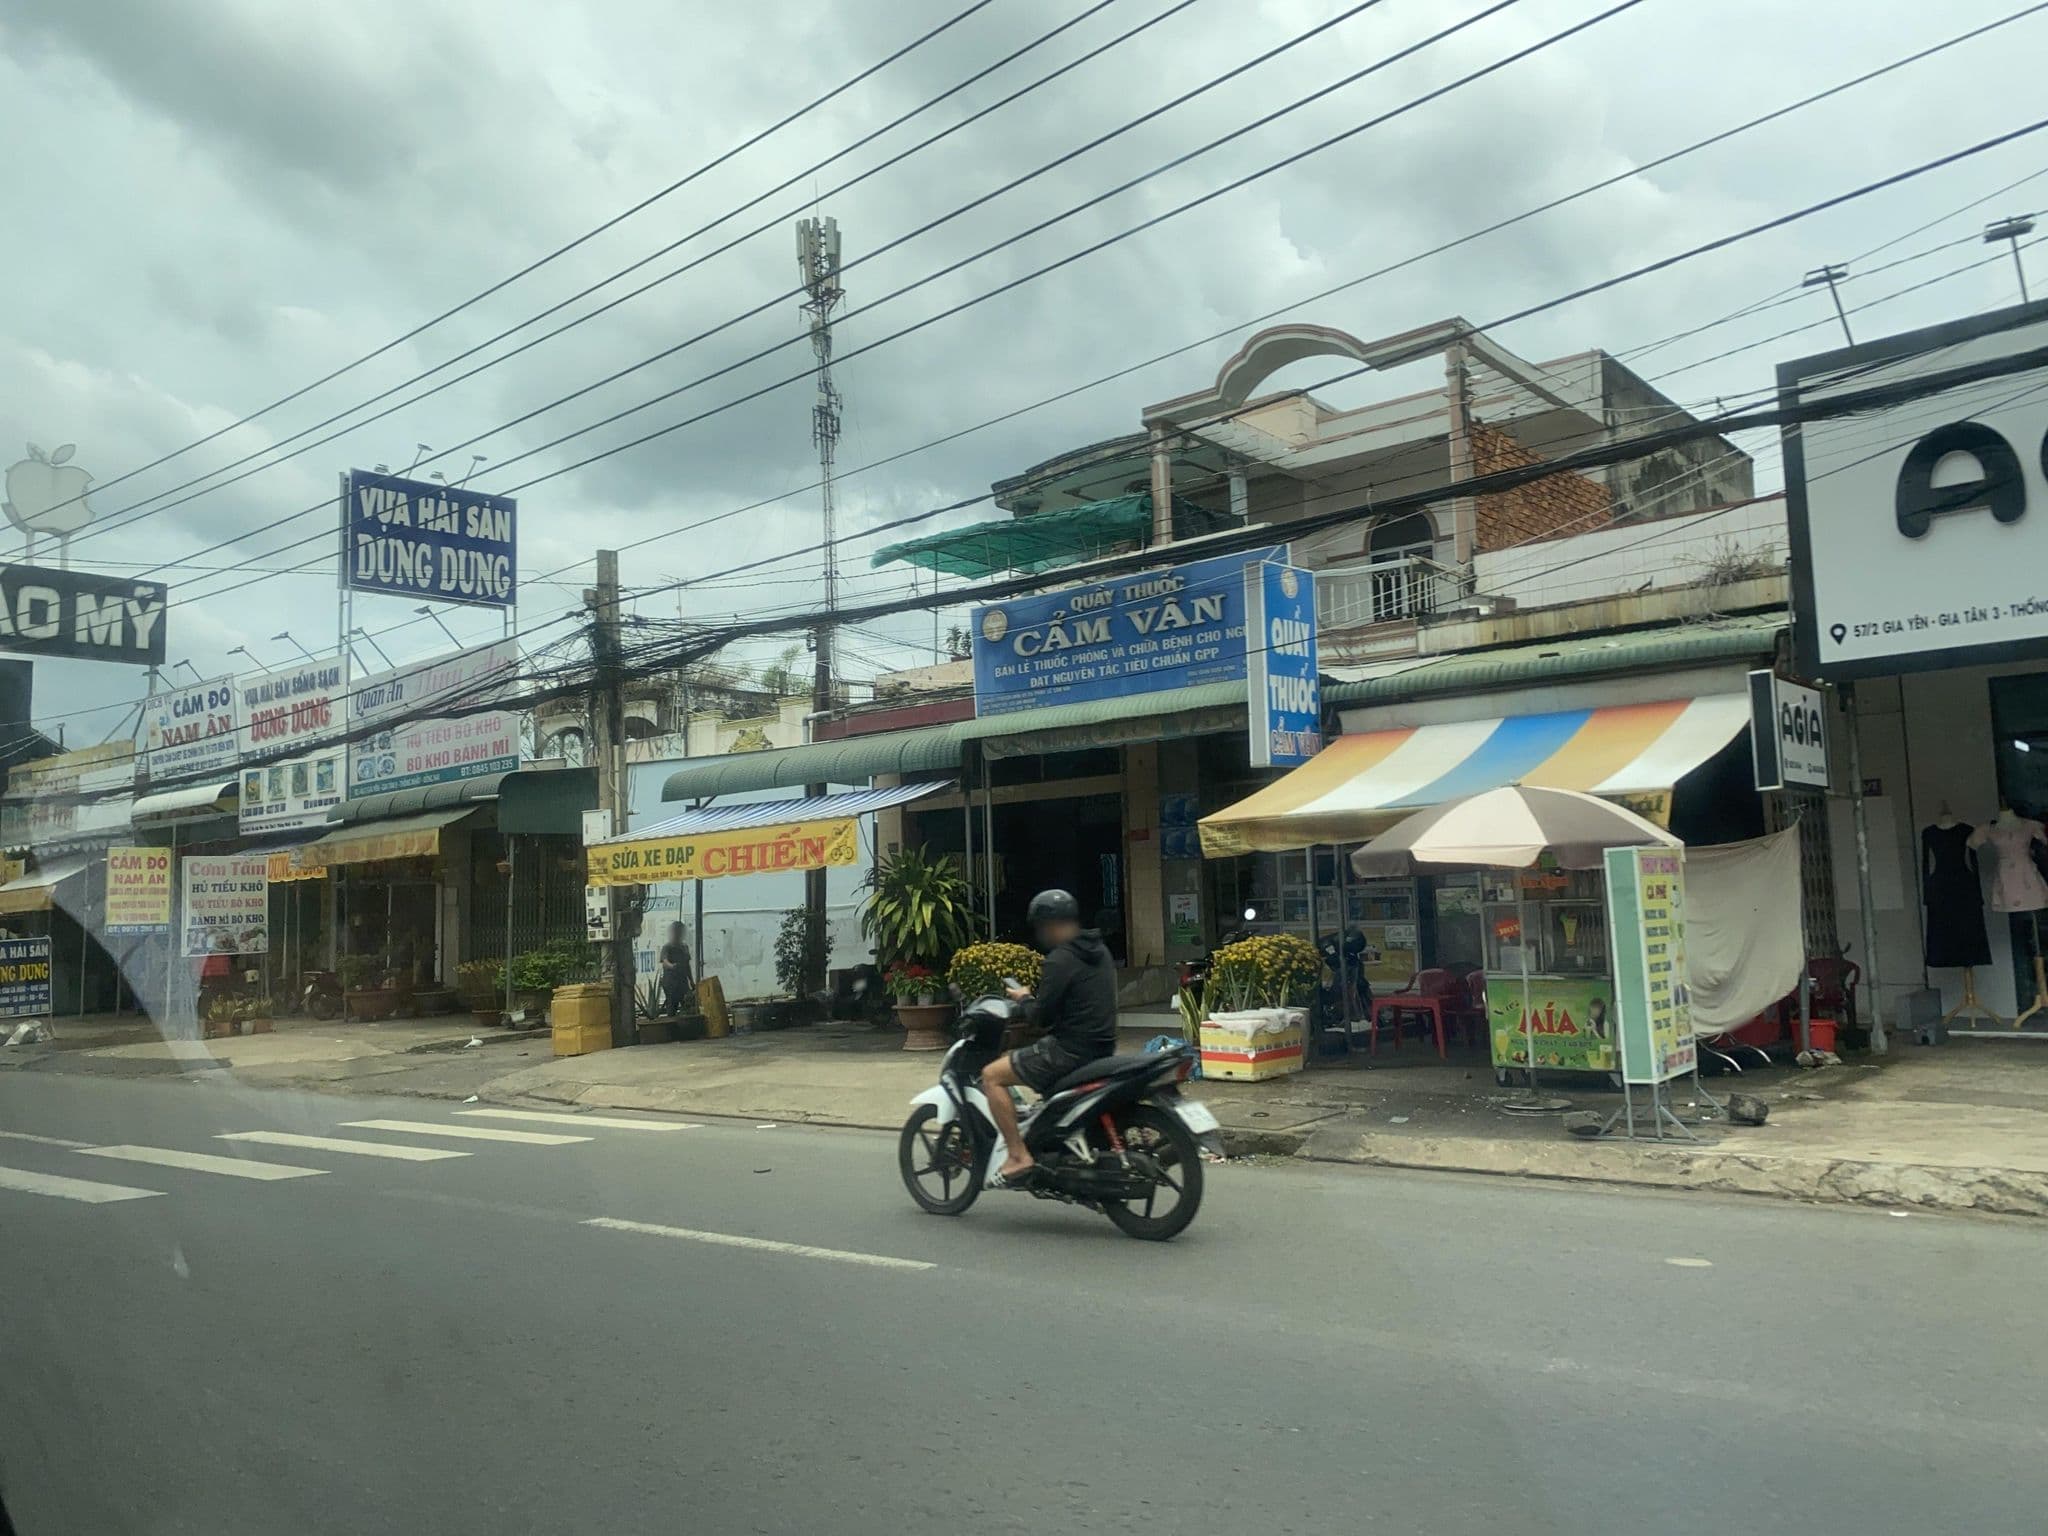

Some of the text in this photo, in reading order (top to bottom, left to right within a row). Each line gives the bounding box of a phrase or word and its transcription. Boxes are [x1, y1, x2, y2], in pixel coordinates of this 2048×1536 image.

[1896, 421, 2048, 538] A
[418, 491, 459, 534] HẢI
[466, 501, 511, 543] SẢN
[440, 546, 511, 598] DUNG
[1070, 571, 1185, 612] QUẦY THUỐC
[75, 585, 165, 649] MỸ
[1013, 593, 1226, 657] CẨM VÂN
[1854, 622, 1879, 638] 57/2
[1882, 619, 1904, 634] GIA
[1907, 613, 1928, 630] YÊN
[1938, 612, 1961, 627] GIA
[1964, 606, 1988, 624] TÂN
[1992, 606, 2000, 620] 3
[1033, 653, 1068, 671] THUỐC
[1072, 648, 1108, 665] PHÒNG
[1111, 644, 1125, 658] VÀ
[1196, 630, 1221, 645] CHO
[1053, 666, 1095, 684] NGUYÊN
[1123, 658, 1148, 674] TIÊU
[1152, 648, 1191, 669] CHUẨN
[1195, 647, 1220, 661] GPP
[1269, 663, 1317, 715] THUỐC
[162, 722, 200, 748] NAM
[426, 750, 450, 768] KHO
[612, 846, 639, 870] SỬA
[644, 849, 661, 867] XE
[666, 846, 694, 868] ĐẠP
[703, 826, 827, 875] CHIẾN
[114, 874, 143, 884] NAM
[192, 880, 208, 893] HỦ
[211, 879, 237, 893] TIẾU
[245, 898, 264, 908] KHO
[246, 914, 265, 923] KHO
[19, 963, 49, 981] DUNG
